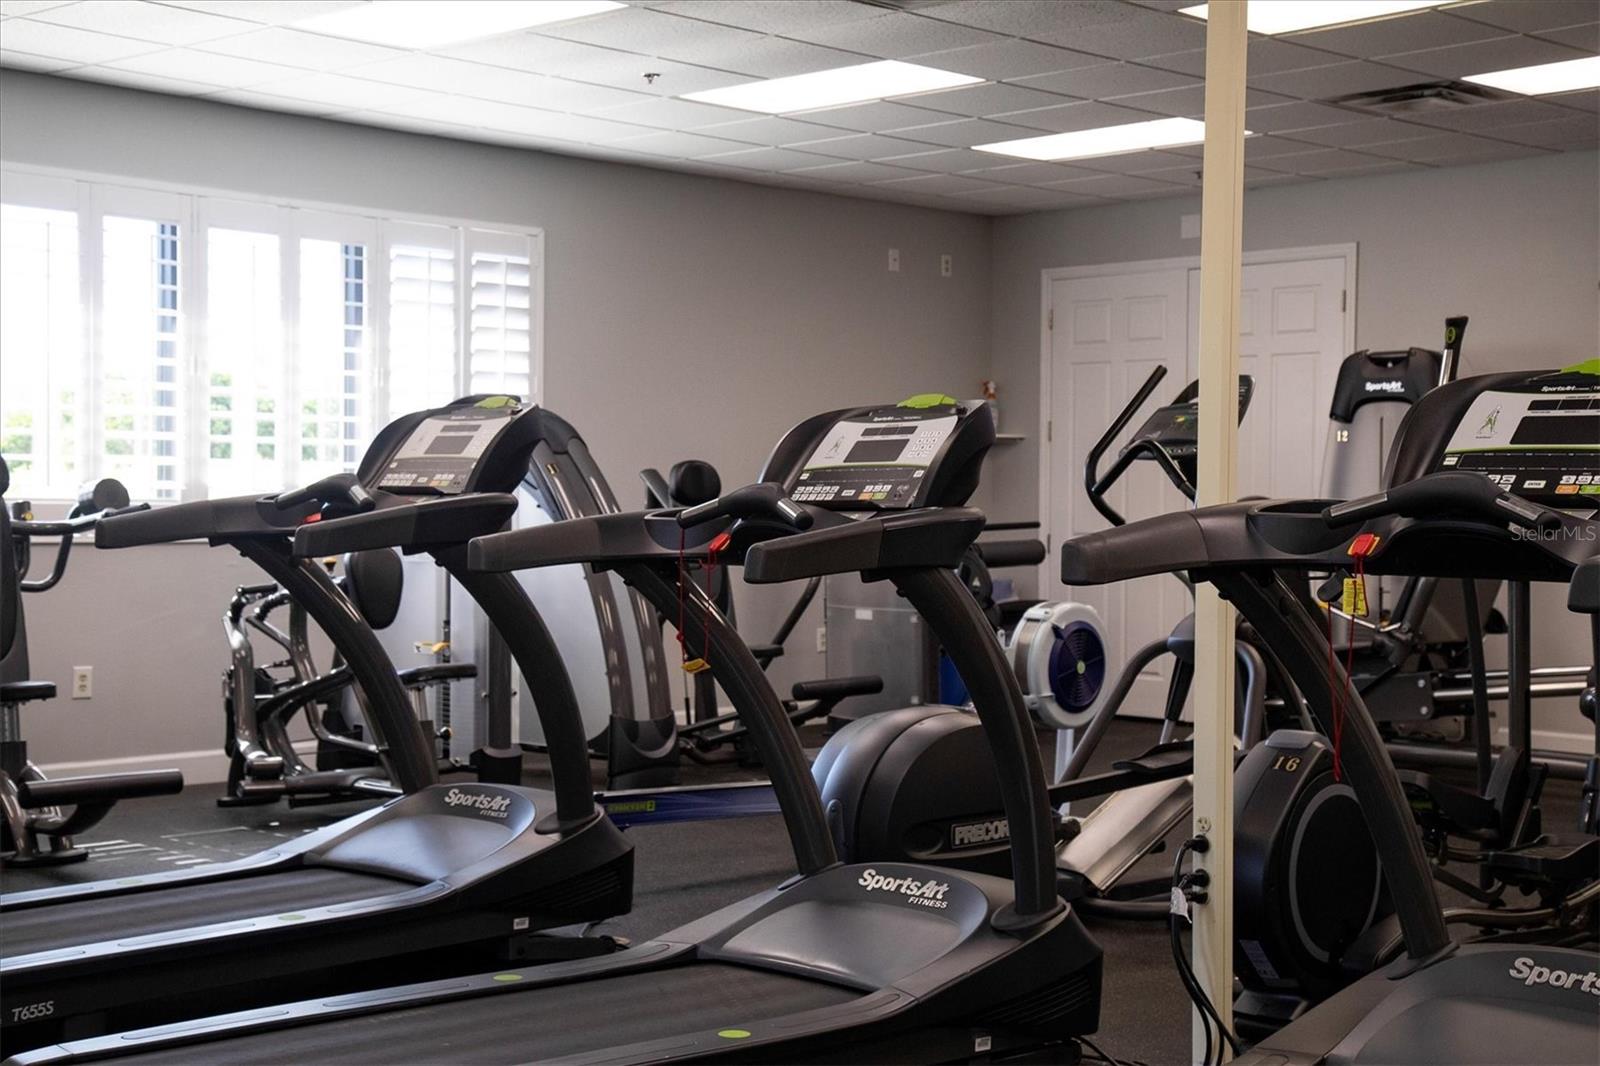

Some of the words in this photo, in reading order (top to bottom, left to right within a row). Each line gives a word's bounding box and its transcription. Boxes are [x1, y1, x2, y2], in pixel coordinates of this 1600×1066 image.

[1336, 430, 1349, 442] 12
[1273, 756, 1300, 771] 16
[444, 788, 511, 811] SportsArt
[955, 820, 1010, 845] PRECOR
[858, 868, 950, 900] SportsArt
[908, 896, 949, 909] FITNESS
[11, 1000, 55, 1022] T655S
